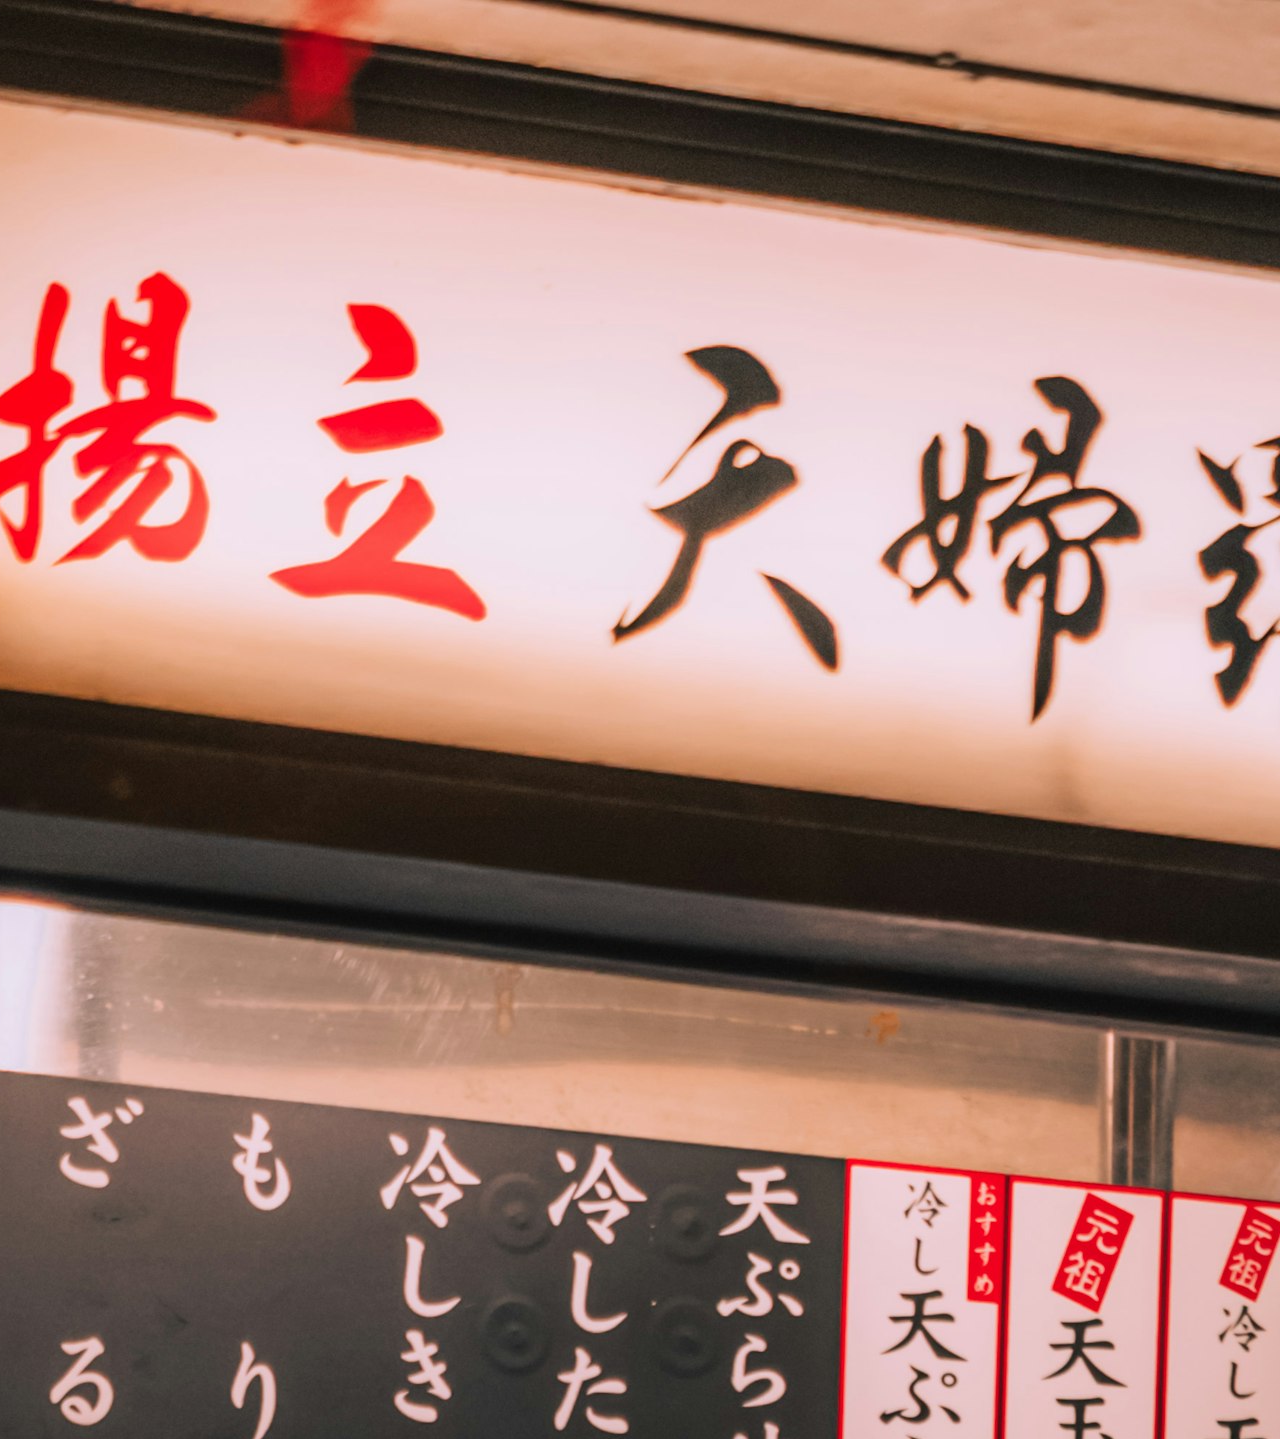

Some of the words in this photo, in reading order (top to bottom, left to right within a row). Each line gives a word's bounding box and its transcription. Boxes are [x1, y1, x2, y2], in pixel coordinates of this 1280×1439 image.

[50, 1096, 144, 1426] ざる
[971, 1178, 1000, 1298] おすすめ
[1058, 1200, 1124, 1306] 元祖
[1225, 1211, 1277, 1297] 元祖
